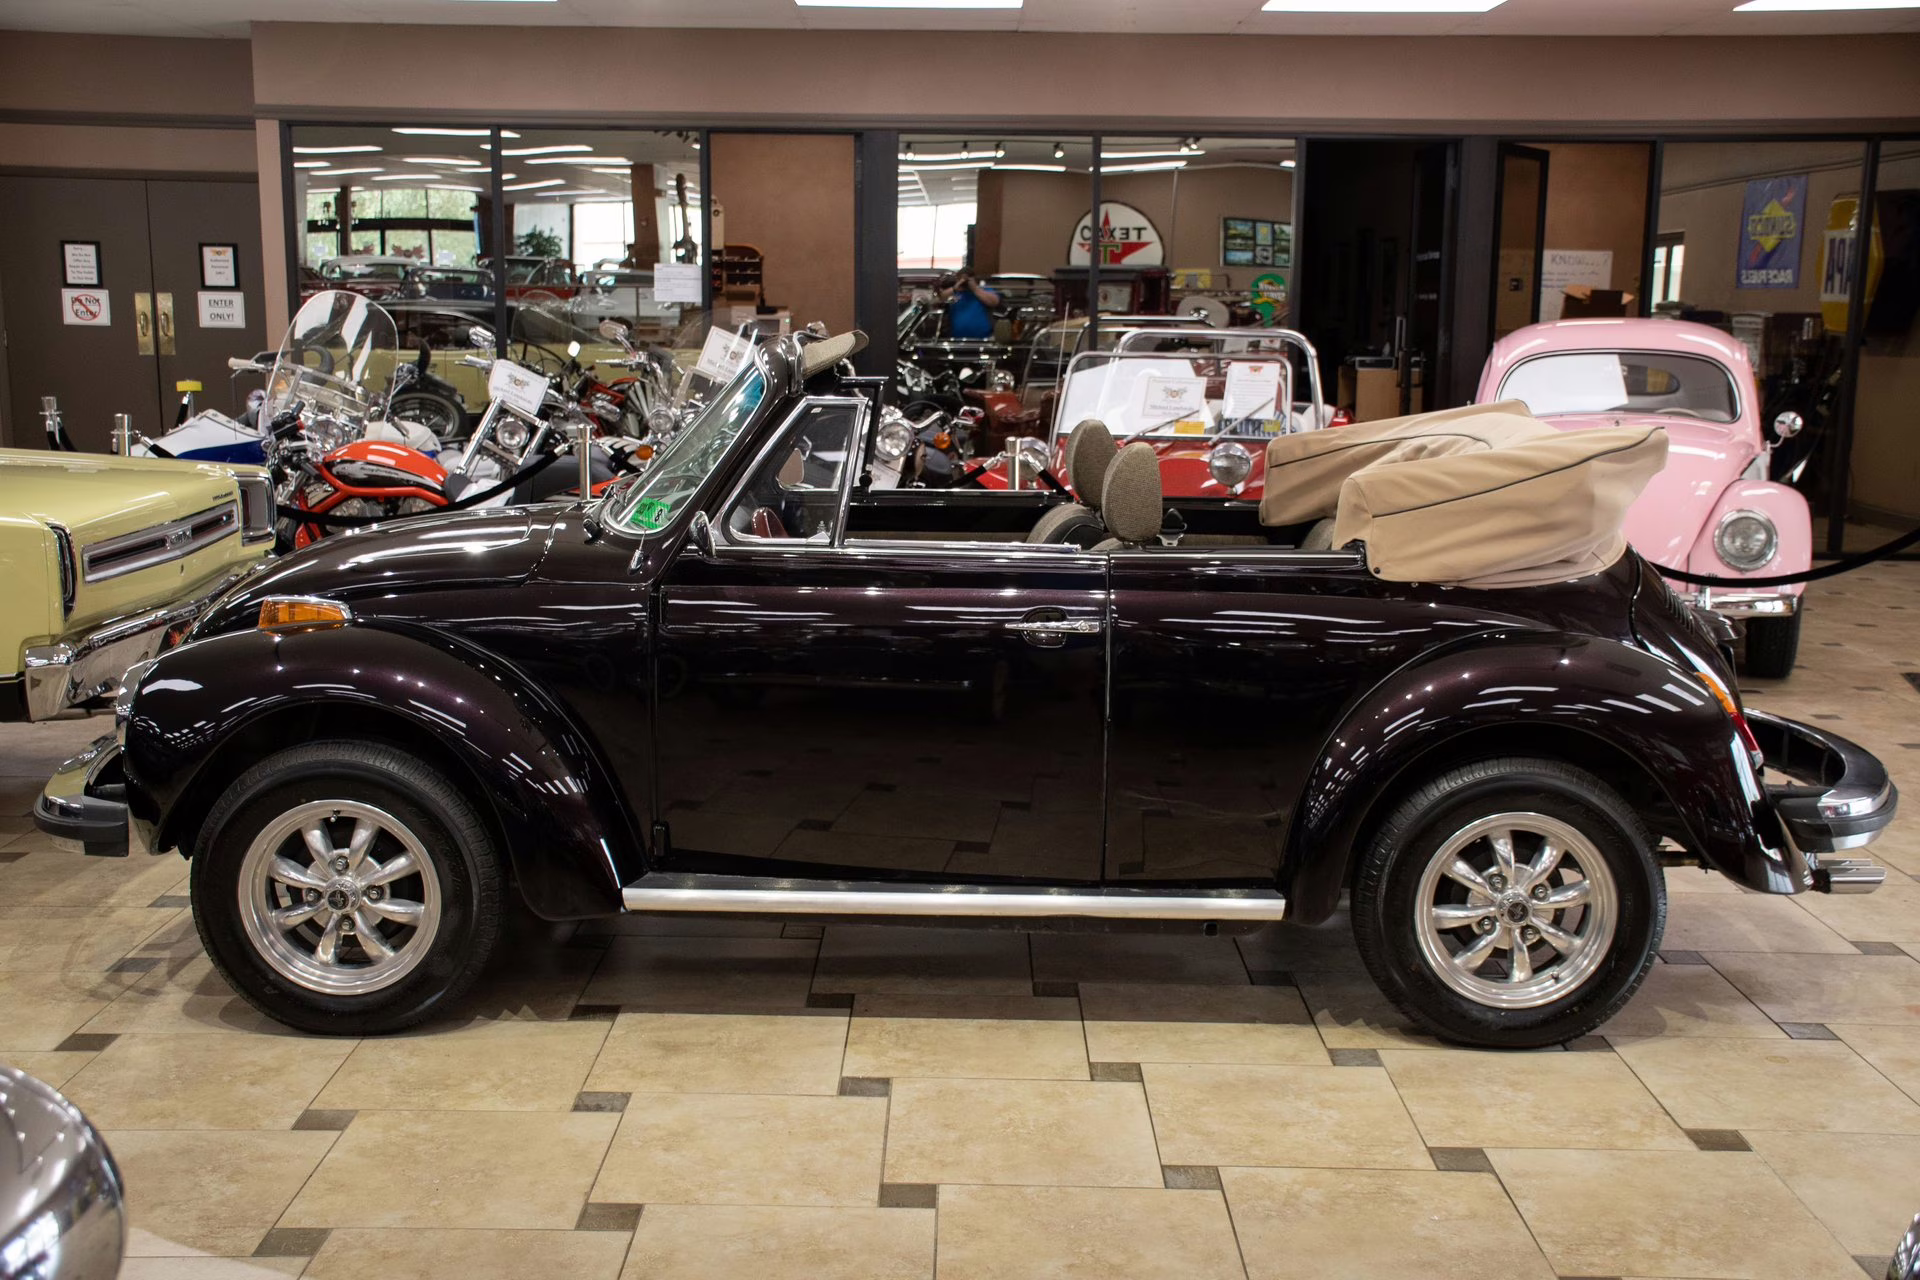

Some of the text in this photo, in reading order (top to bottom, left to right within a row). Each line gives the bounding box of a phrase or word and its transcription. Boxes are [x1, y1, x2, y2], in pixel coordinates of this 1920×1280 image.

[208, 299, 234, 307] ENTER
[75, 309, 98, 317] Enter
[209, 312, 234, 320] ONLY!
